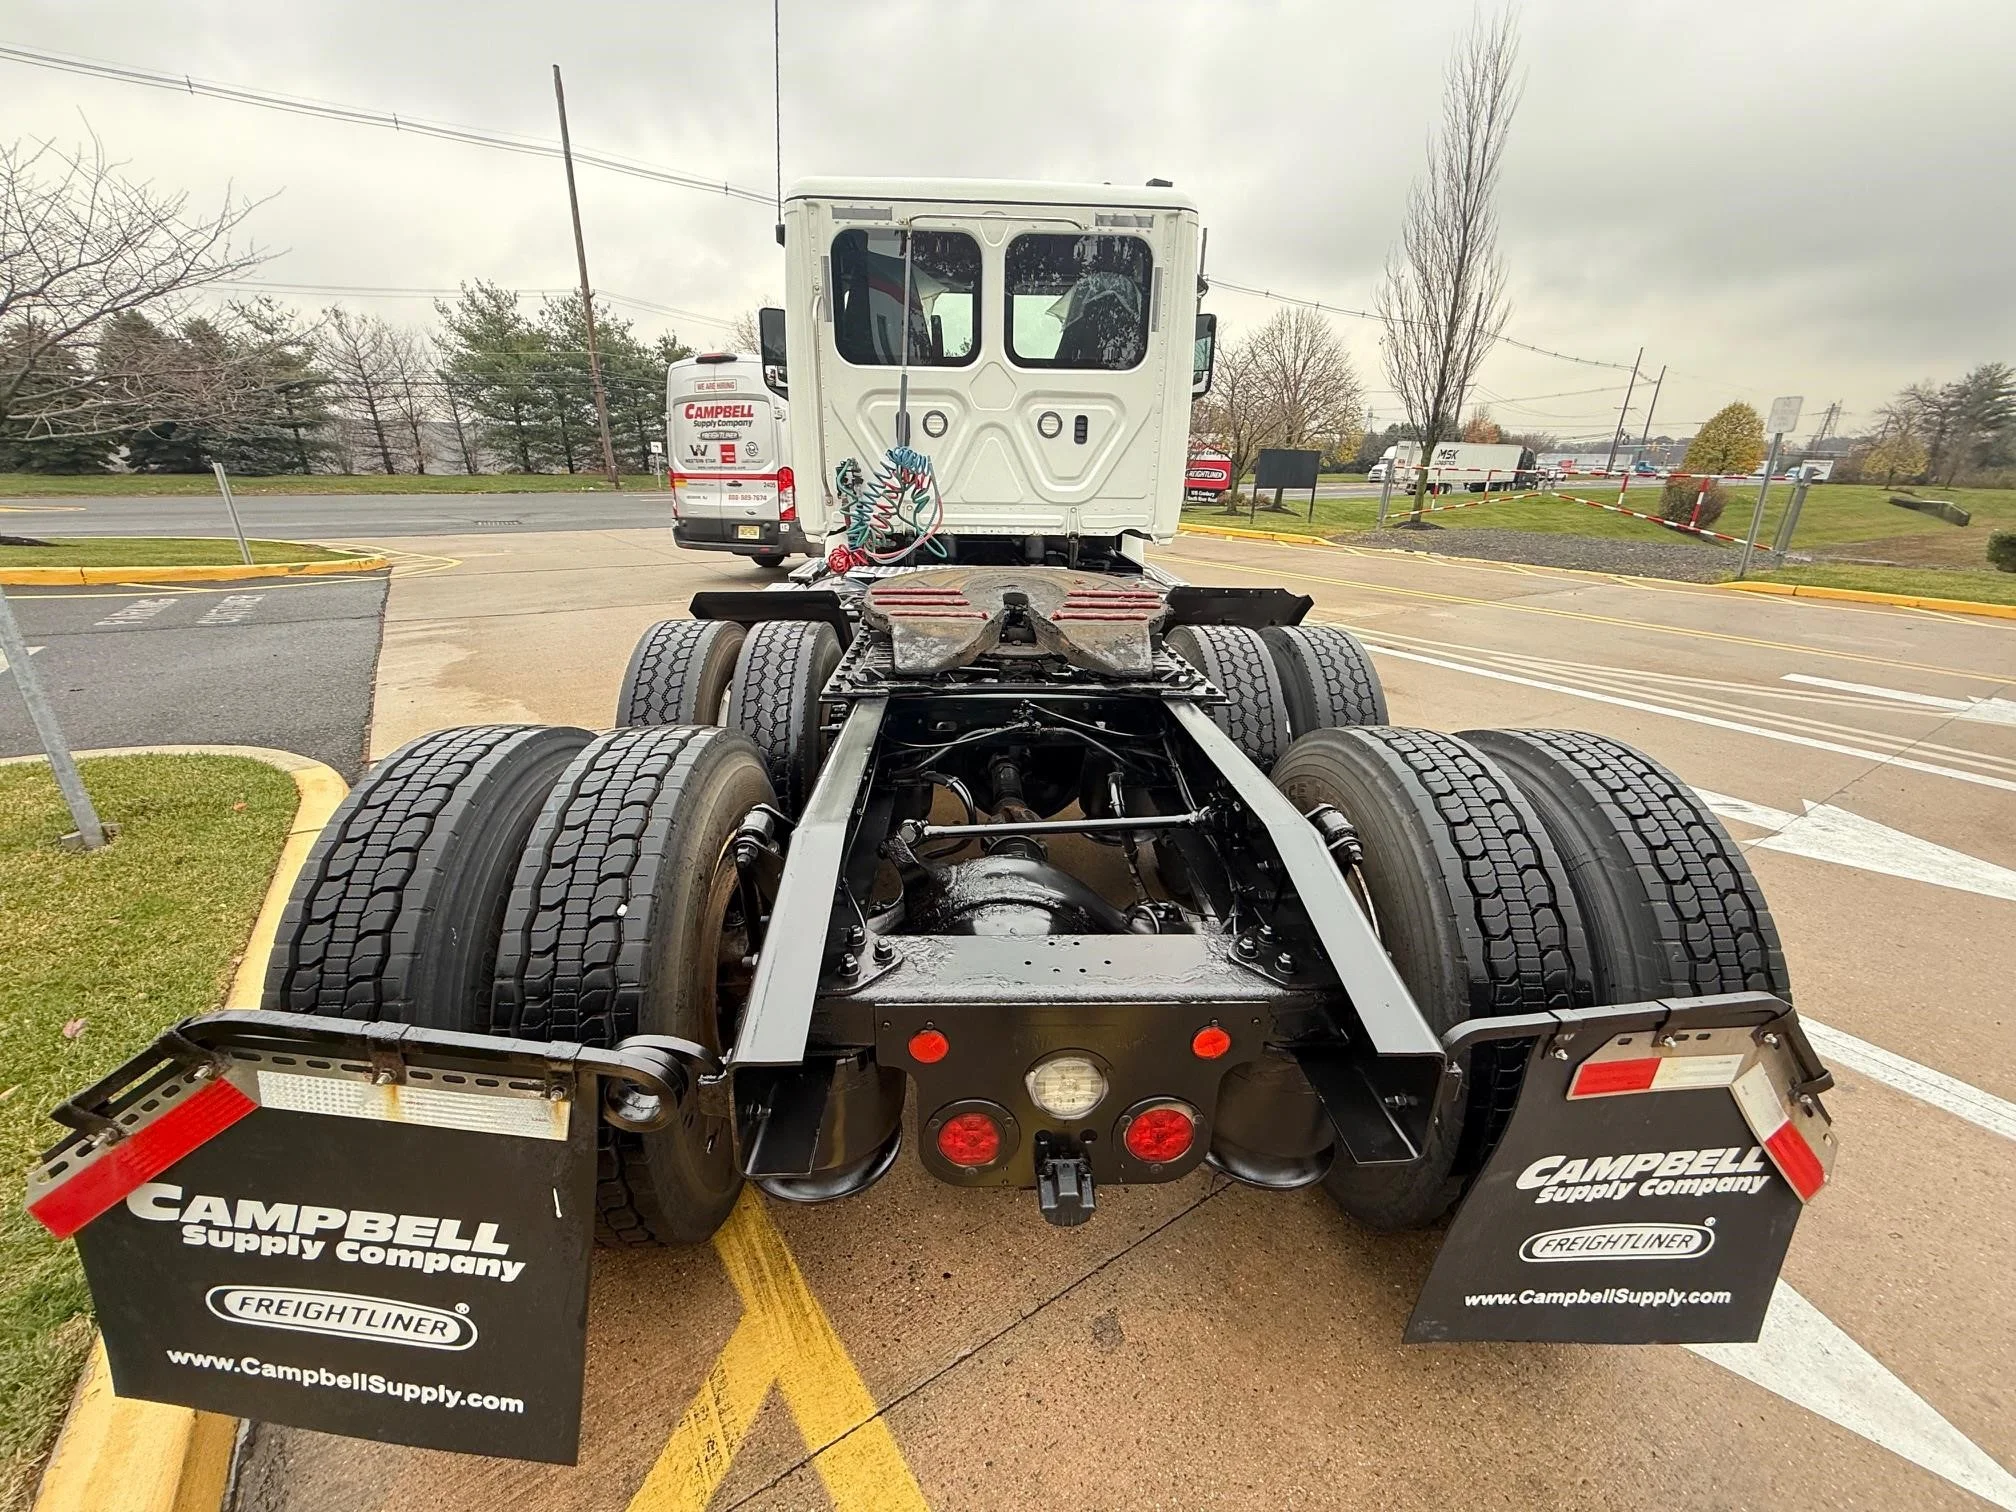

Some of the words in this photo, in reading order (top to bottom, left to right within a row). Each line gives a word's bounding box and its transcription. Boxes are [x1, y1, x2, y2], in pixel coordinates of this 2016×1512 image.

[717, 381, 735, 389] HIRING
[684, 403, 754, 420] CAMPBELL
[693, 420, 717, 428] Supply
[718, 419, 754, 428] Company
[1437, 449, 1460, 460] MSK
[1515, 1146, 1767, 1190] CAMPBELL
[1534, 1178, 1638, 1204] Supply
[1638, 1174, 1771, 1198] Company
[125, 1182, 511, 1256] CAMPBELL
[181, 1224, 327, 1261] Supply
[334, 1240, 527, 1283] Company
[1539, 1232, 1695, 1254] FREIGHTLINER
[1463, 1287, 1733, 1308] www.CampbellSupply.com
[237, 1295, 450, 1339] FREIGHTLINER
[165, 1347, 526, 1414] www.CampbellSupply.com
